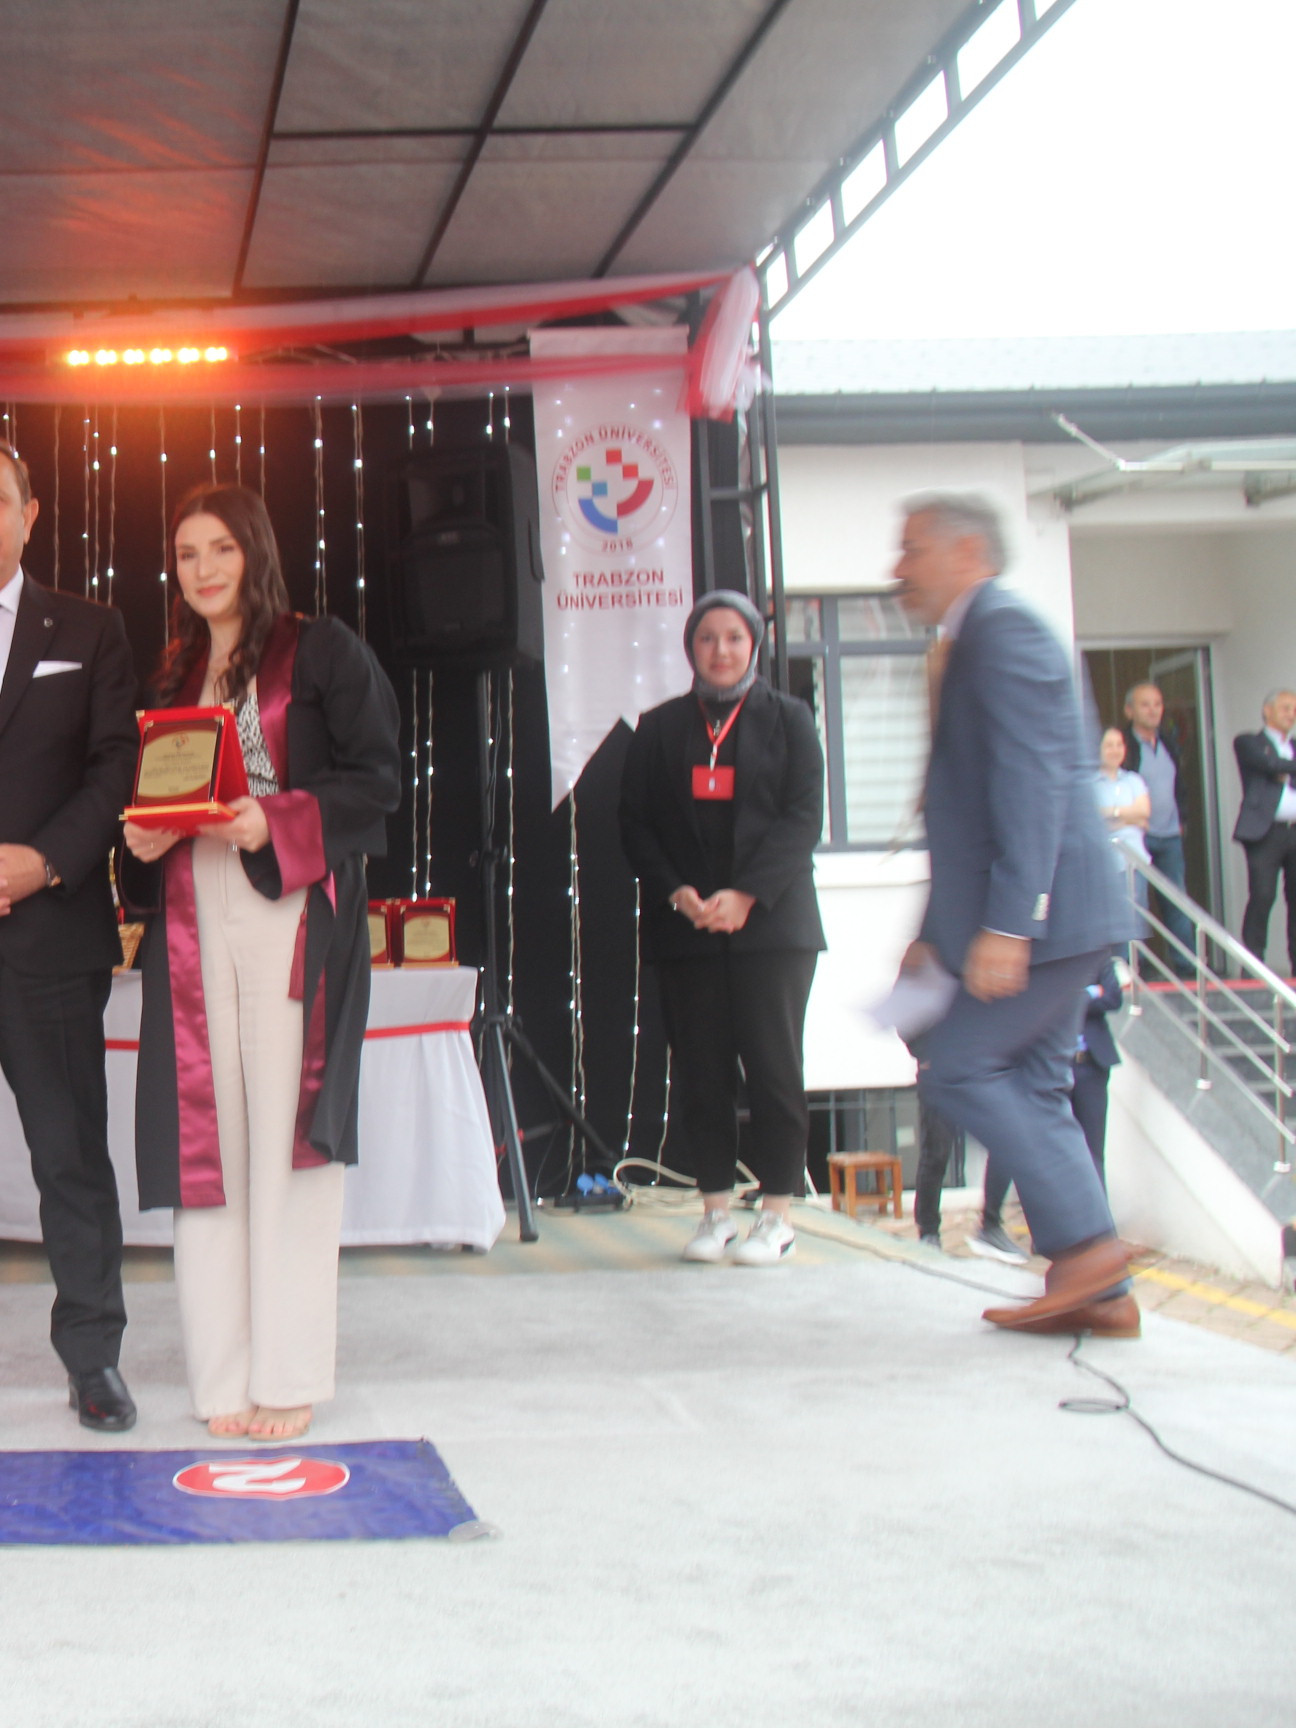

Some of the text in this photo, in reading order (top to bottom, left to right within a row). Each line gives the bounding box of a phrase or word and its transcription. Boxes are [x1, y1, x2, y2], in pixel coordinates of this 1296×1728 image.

[555, 431, 594, 493] TRABZON
[573, 568, 664, 588] TRABZON
[556, 585, 683, 610] ÜNİVERSİTESİ
[208, 1458, 306, 1493] 2
